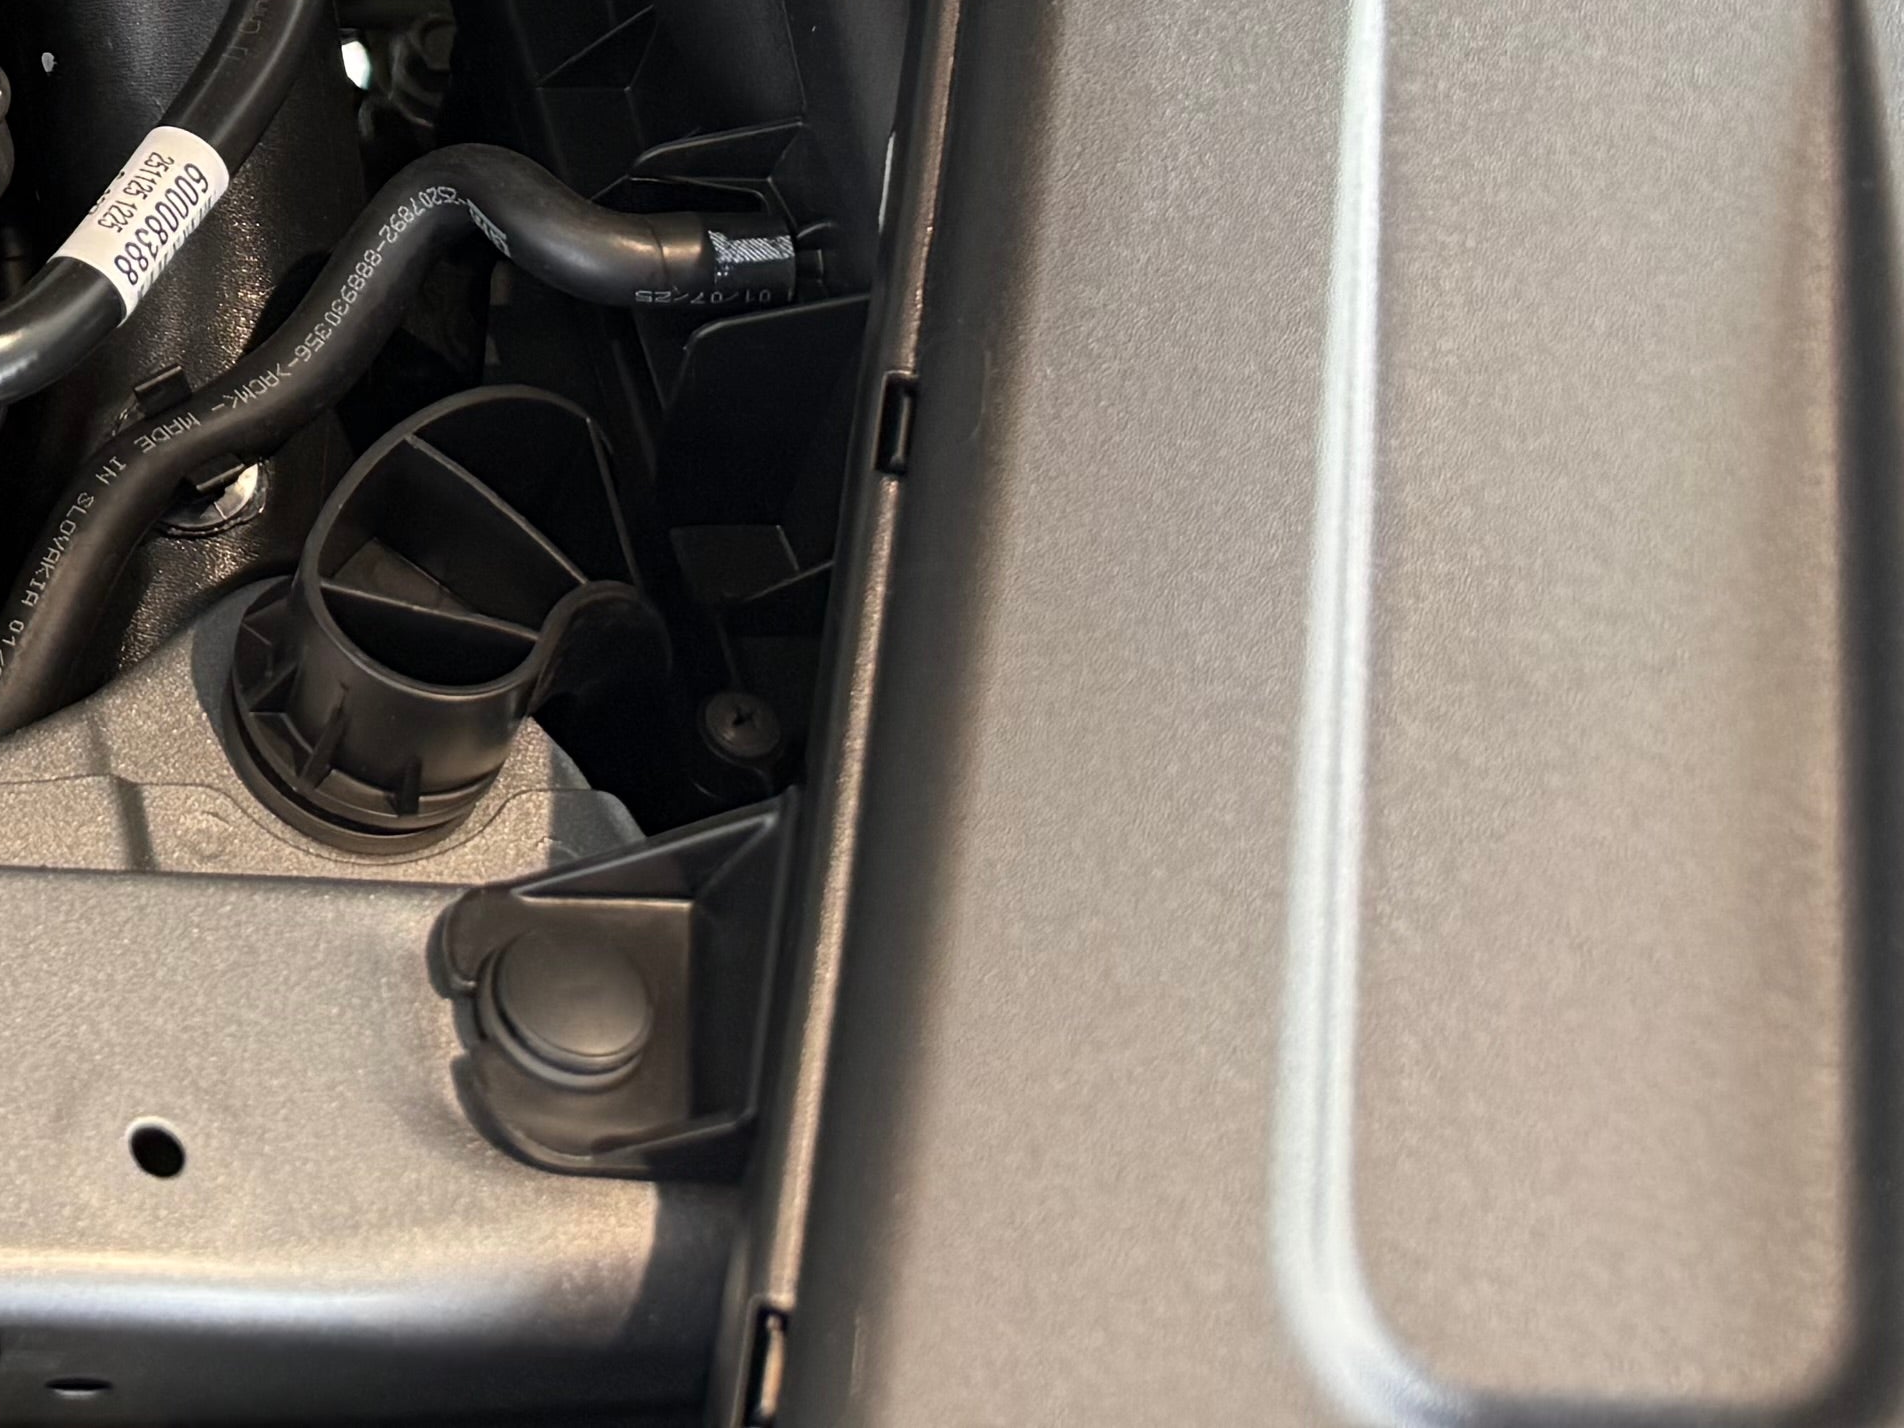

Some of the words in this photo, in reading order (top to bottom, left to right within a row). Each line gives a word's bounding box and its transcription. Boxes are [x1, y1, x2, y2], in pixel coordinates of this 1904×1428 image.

[123, 151, 175, 200] 251125
[97, 199, 138, 233] 1225
[114, 162, 209, 285] 60008388
[133, 411, 202, 454] MADE
[95, 455, 127, 486] IN
[20, 491, 95, 607] SLOVAKIA
